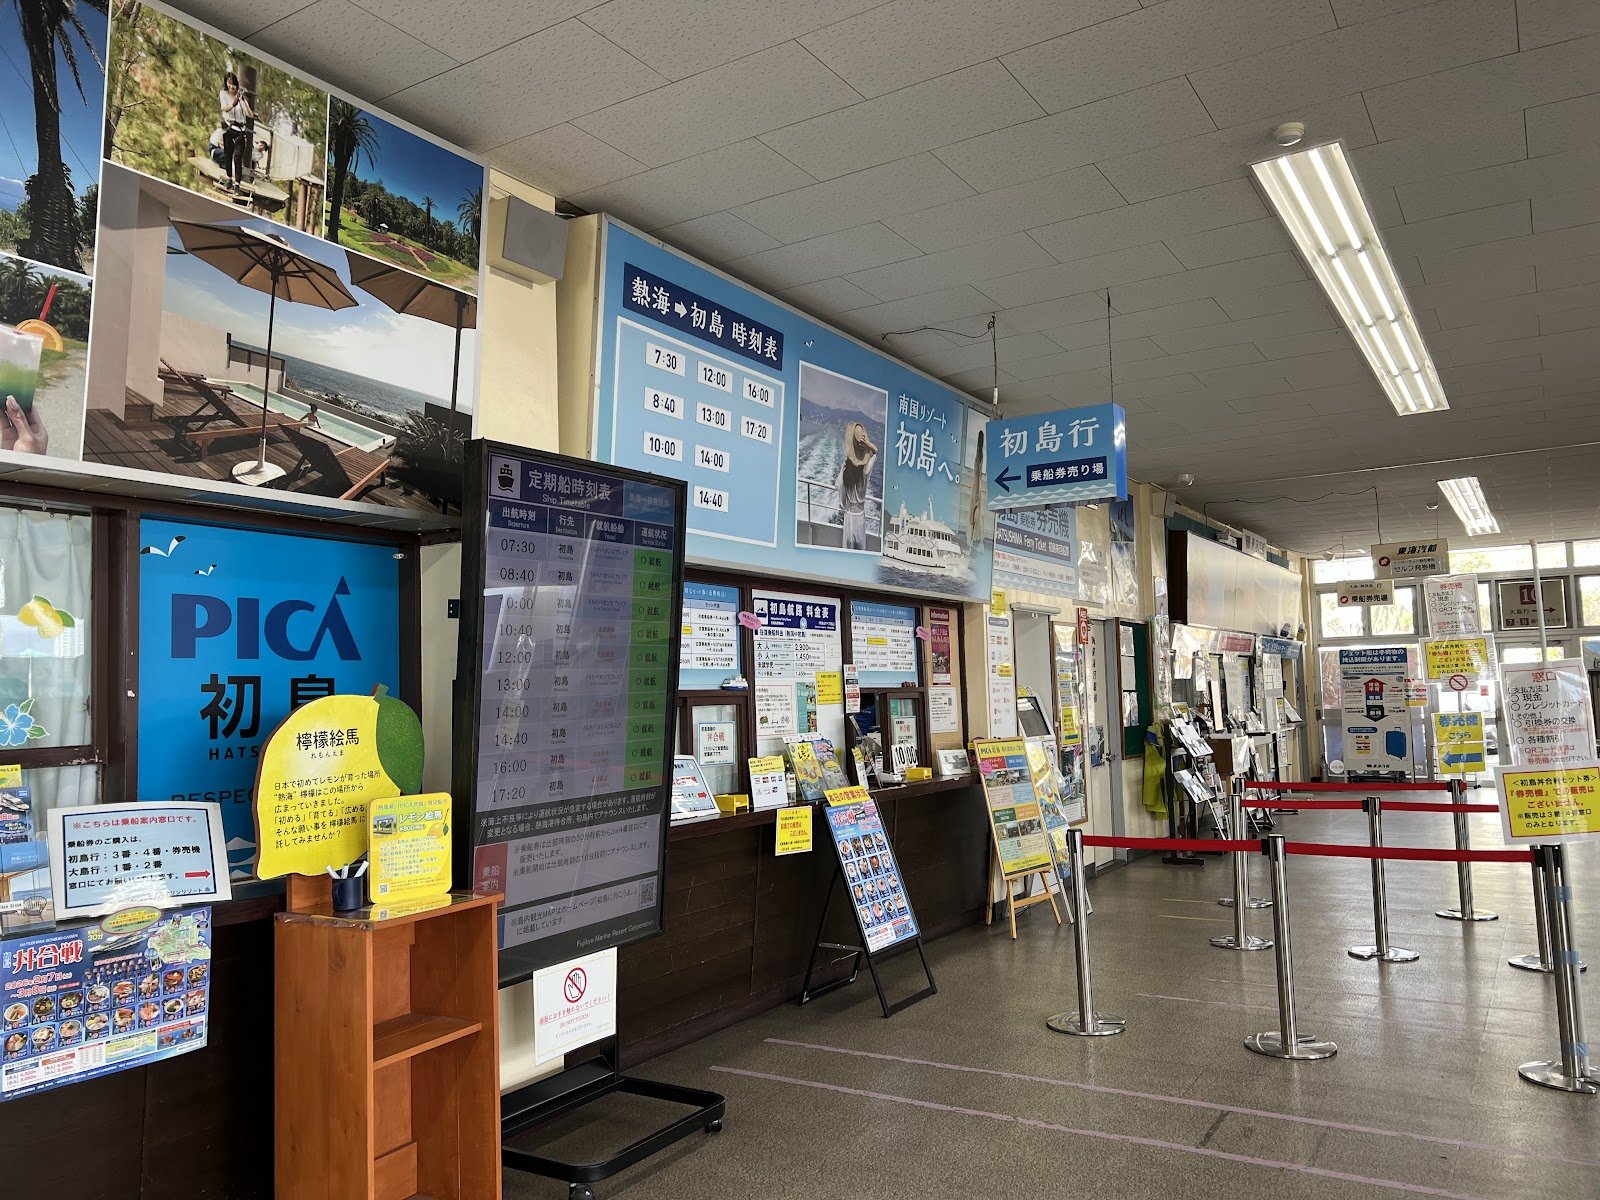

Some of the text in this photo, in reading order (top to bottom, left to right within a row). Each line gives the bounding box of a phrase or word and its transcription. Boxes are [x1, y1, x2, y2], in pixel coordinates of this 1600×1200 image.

[632, 277, 777, 361] 熱海 初島 時刻表
[654, 350, 677, 370] 7:30
[703, 367, 726, 387] 12:00
[748, 384, 769, 402] 16:00
[652, 394, 675, 413] 8:40
[899, 393, 947, 430] 南国リゾート
[702, 407, 725, 426] 13:00
[746, 421, 767, 439] 17:20
[999, 417, 1099, 458] 初島行
[650, 437, 676, 456] 10:00
[895, 421, 960, 484] 初島へ。
[701, 450, 724, 467] 14:00
[1030, 462, 1104, 482] 乗船券売り場
[528, 470, 611, 501] 定期船時刻表
[542, 494, 591, 509] Ship Timetable
[700, 491, 723, 507] 14:40
[502, 507, 536, 521] 出航時刻
[559, 515, 575, 527] 行先
[500, 539, 535, 555] 07:30
[558, 543, 574, 555] 初島
[1397, 544, 1437, 555] 東海汽船
[500, 568, 534, 582] 08:40
[558, 571, 573, 582] 初島
[557, 597, 572, 609] 初島
[1351, 595, 1388, 603] 乗船券売場
[770, 601, 829, 619] 初島航路 料金表
[171, 576, 362, 662] PICA
[500, 624, 532, 637] 10:40
[556, 624, 571, 635] 初島
[498, 651, 531, 664] 12:00
[555, 650, 570, 661] 初島
[497, 678, 531, 691] 13:00
[553, 675, 568, 686] 初島
[1532, 672, 1556, 682] 窓口
[1522, 693, 1542, 702] 現金
[1524, 701, 1583, 710] クレジットカード
[495, 705, 529, 718] 14:00
[552, 702, 567, 713] 初島
[1439, 714, 1479, 727] 券売機
[1525, 717, 1576, 727] 引換券の交換
[296, 728, 360, 751] 檸檬絵馬
[494, 732, 528, 746] 14:40
[551, 728, 566, 740] 初島
[1528, 735, 1563, 744] 各種割引
[311, 749, 345, 759] れもんえま
[493, 759, 527, 774] 16:00
[550, 754, 565, 764] 初島
[274, 769, 381, 791] 日本で初めてレモンが育った場所
[300, 783, 364, 799] 檸檬はこの場所から
[492, 787, 526, 802] 17:20
[549, 779, 564, 791] 初島
[274, 797, 345, 814] 広まっていきました。
[1527, 799, 1584, 809] ございません。
[73, 816, 196, 829] ※こちらは乗船案内窓口です。
[399, 809, 443, 824] レモン絵馬
[1525, 820, 1580, 829] のみとなります。
[275, 819, 327, 837] そんな願い事を
[67, 836, 142, 848] 乗船券のご購入は、
[275, 829, 341, 849] 託してみませんか？
[519, 850, 563, 864] 販売いたします。
[69, 873, 180, 890] 窓口にてお願います。
[576, 935, 594, 948] Fujikyu
[612, 927, 628, 937] Resort
